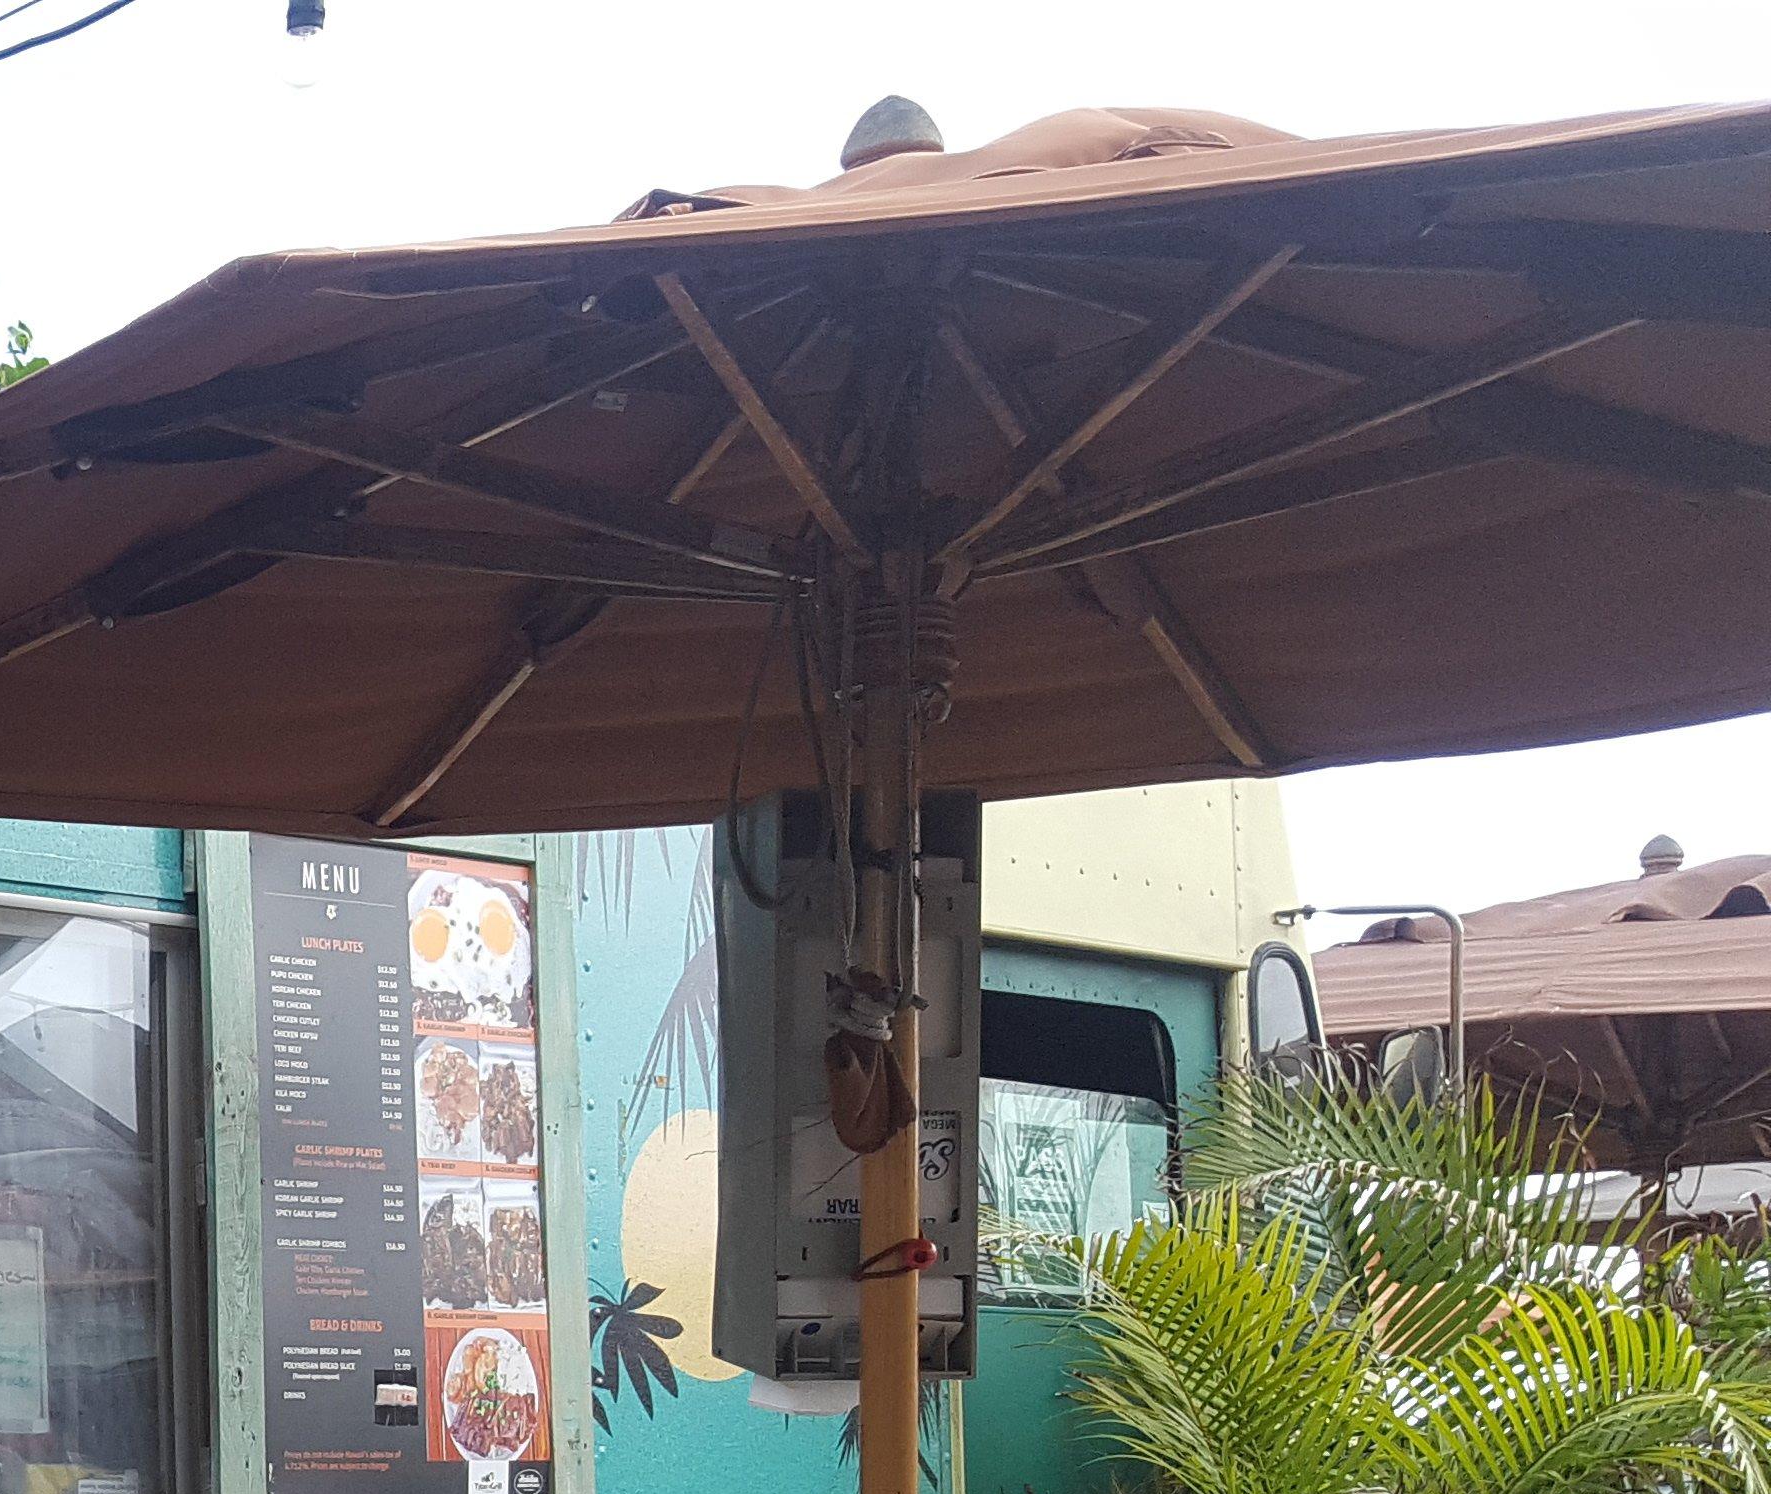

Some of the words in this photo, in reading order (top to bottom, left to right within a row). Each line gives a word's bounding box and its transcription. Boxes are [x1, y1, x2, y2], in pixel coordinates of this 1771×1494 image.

[302, 861, 360, 894] MENU
[301, 936, 331, 950] LUNCH
[332, 938, 364, 953] PLATES
[295, 1144, 322, 1155] GARLIC
[325, 1145, 354, 1156] SHRIMP
[356, 1147, 383, 1158] PLATES
[274, 1180, 295, 1188] GARLIC
[309, 1318, 339, 1331] BREAD
[341, 1320, 349, 1331] &
[350, 1320, 383, 1332] DRINKS
